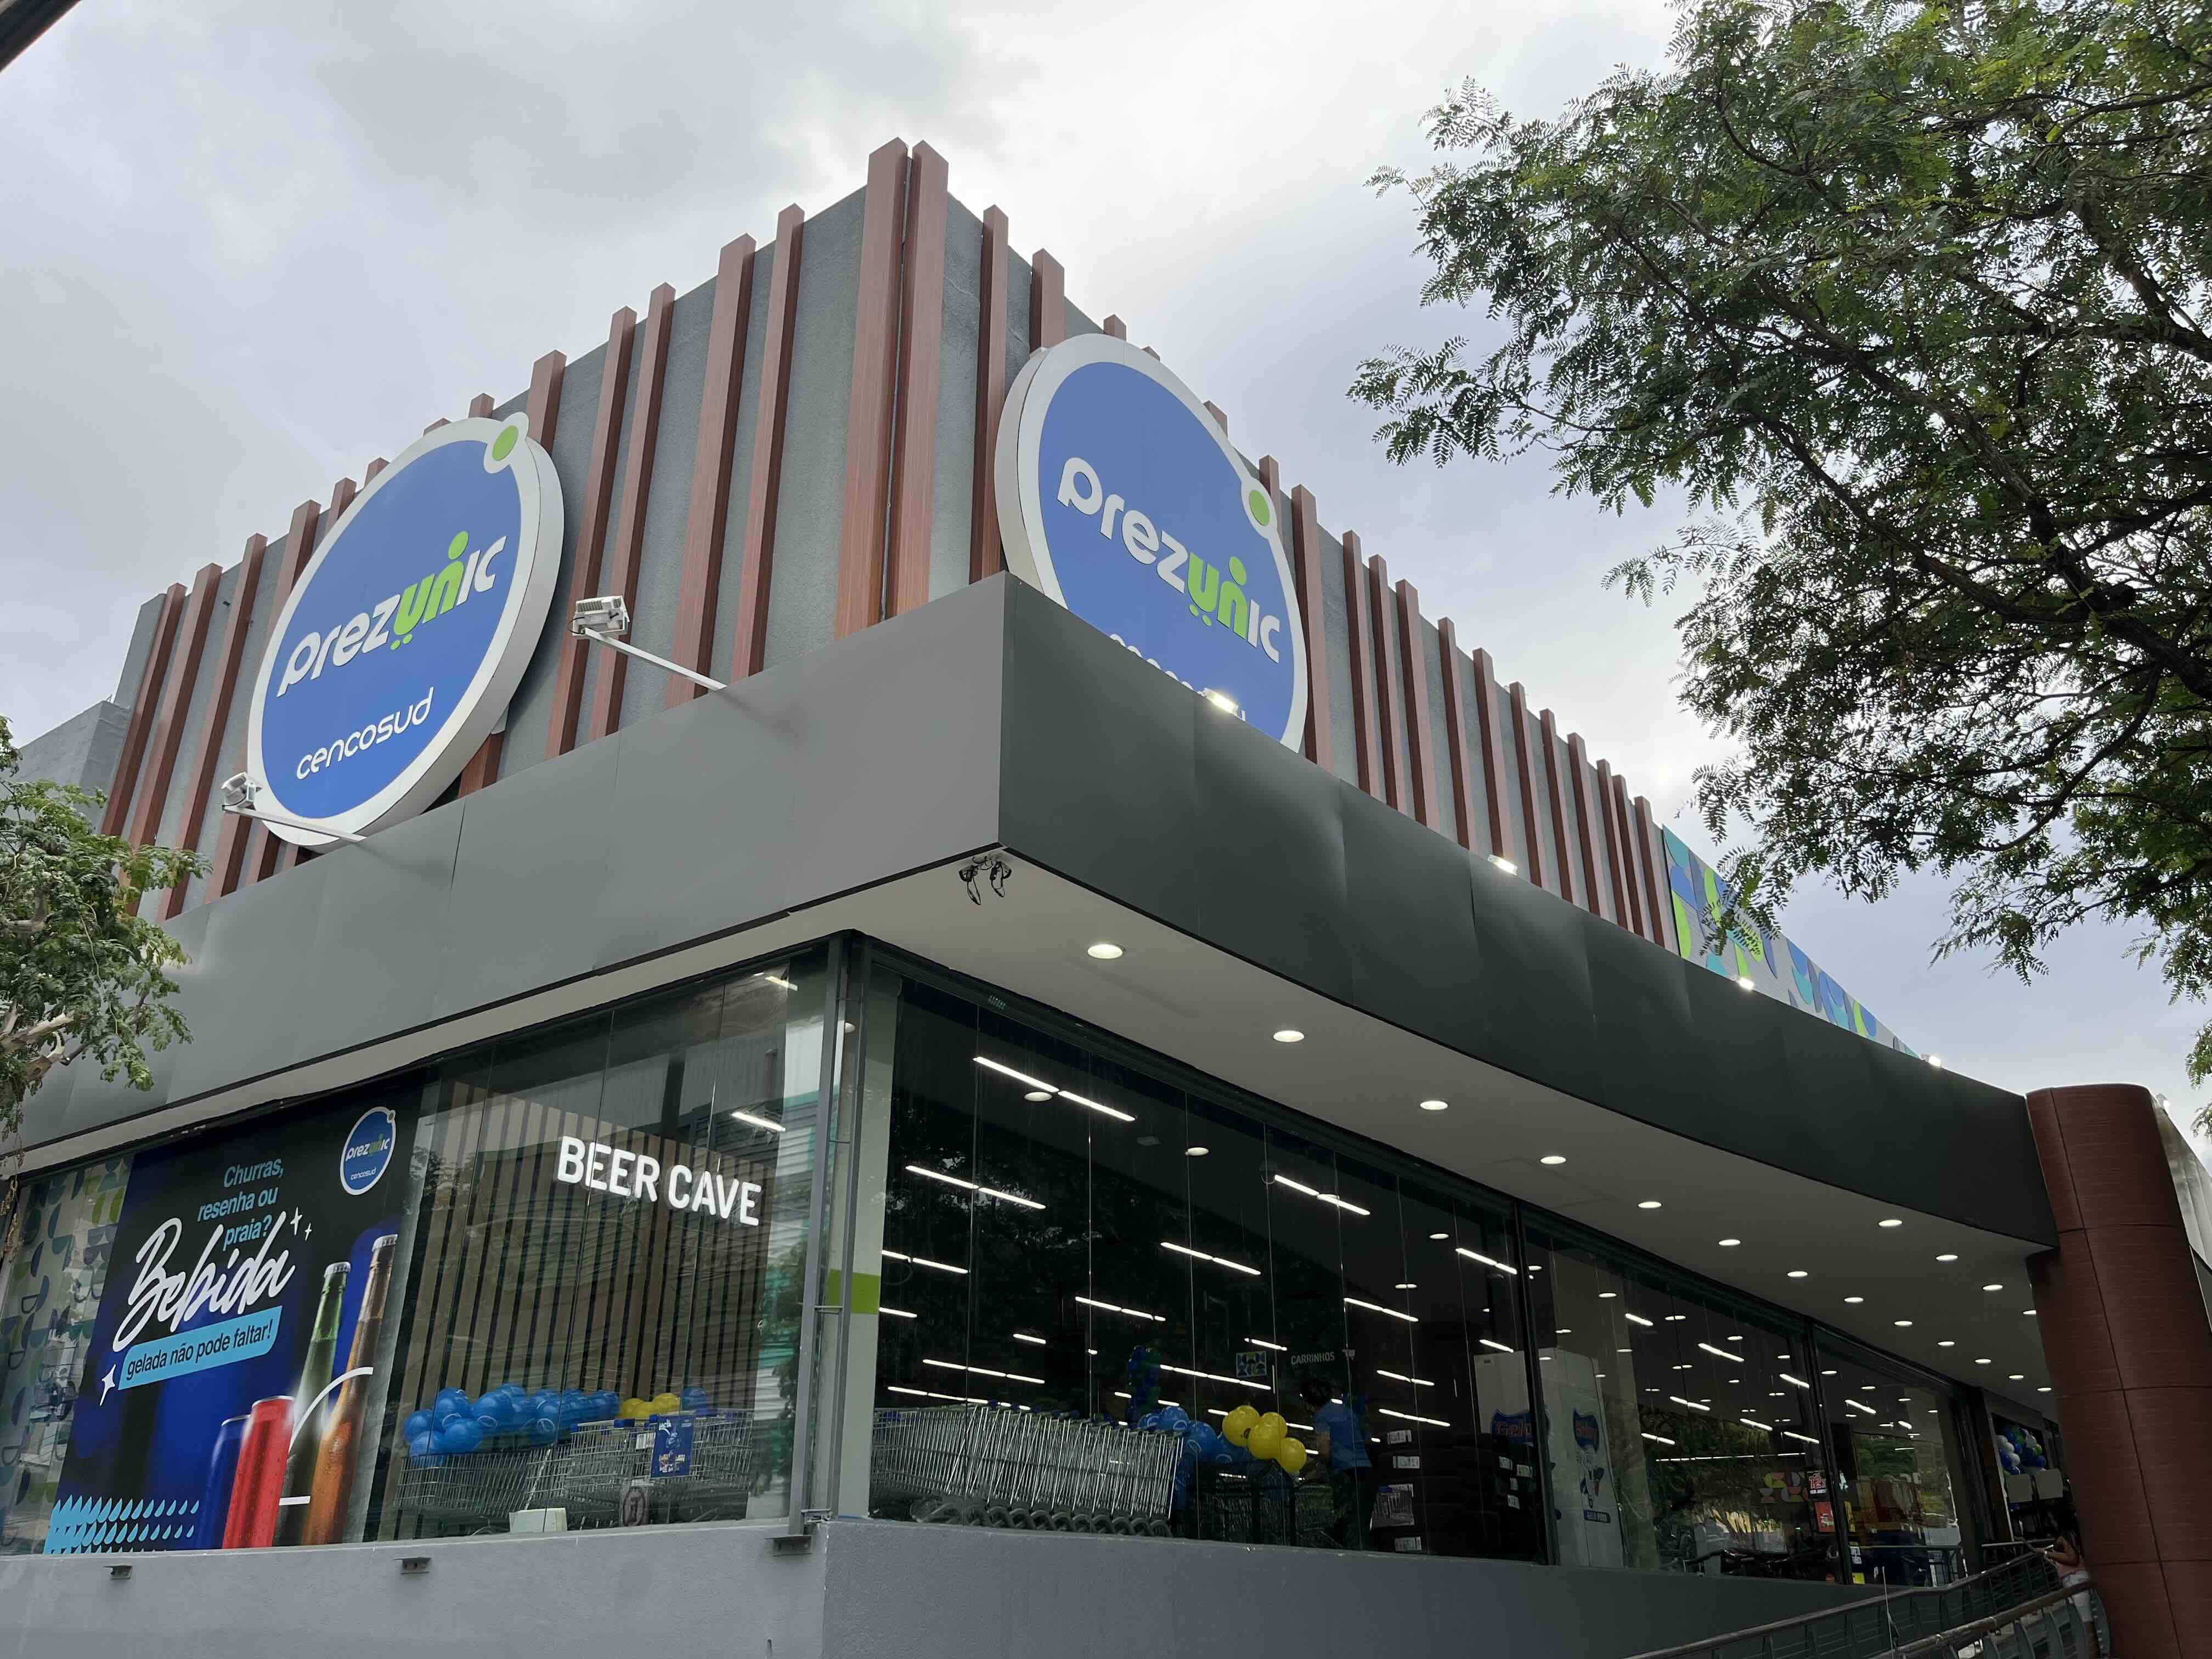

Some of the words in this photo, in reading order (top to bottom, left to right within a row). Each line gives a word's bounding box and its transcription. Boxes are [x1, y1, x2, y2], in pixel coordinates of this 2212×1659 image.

[1057, 457, 1280, 664] prezunic
[276, 531, 507, 697] prezunic
[297, 687, 433, 780] cencosud
[346, 1133, 391, 1161] prezunic
[224, 1159, 284, 1187] Churras,
[351, 1167, 376, 1180] cencosud
[557, 1135, 659, 1202] BEER
[668, 1165, 763, 1226] CAVE
[198, 1191, 255, 1222] resenha
[258, 1187, 279, 1207] ou
[223, 1215, 273, 1251] praia?
[112, 1211, 296, 1352] Bebida
[126, 1349, 167, 1380] gelada
[170, 1342, 193, 1365] não
[196, 1333, 230, 1363] pode
[233, 1319, 273, 1348] faltar!
[1291, 1351, 1335, 1365] CARRINHOS
